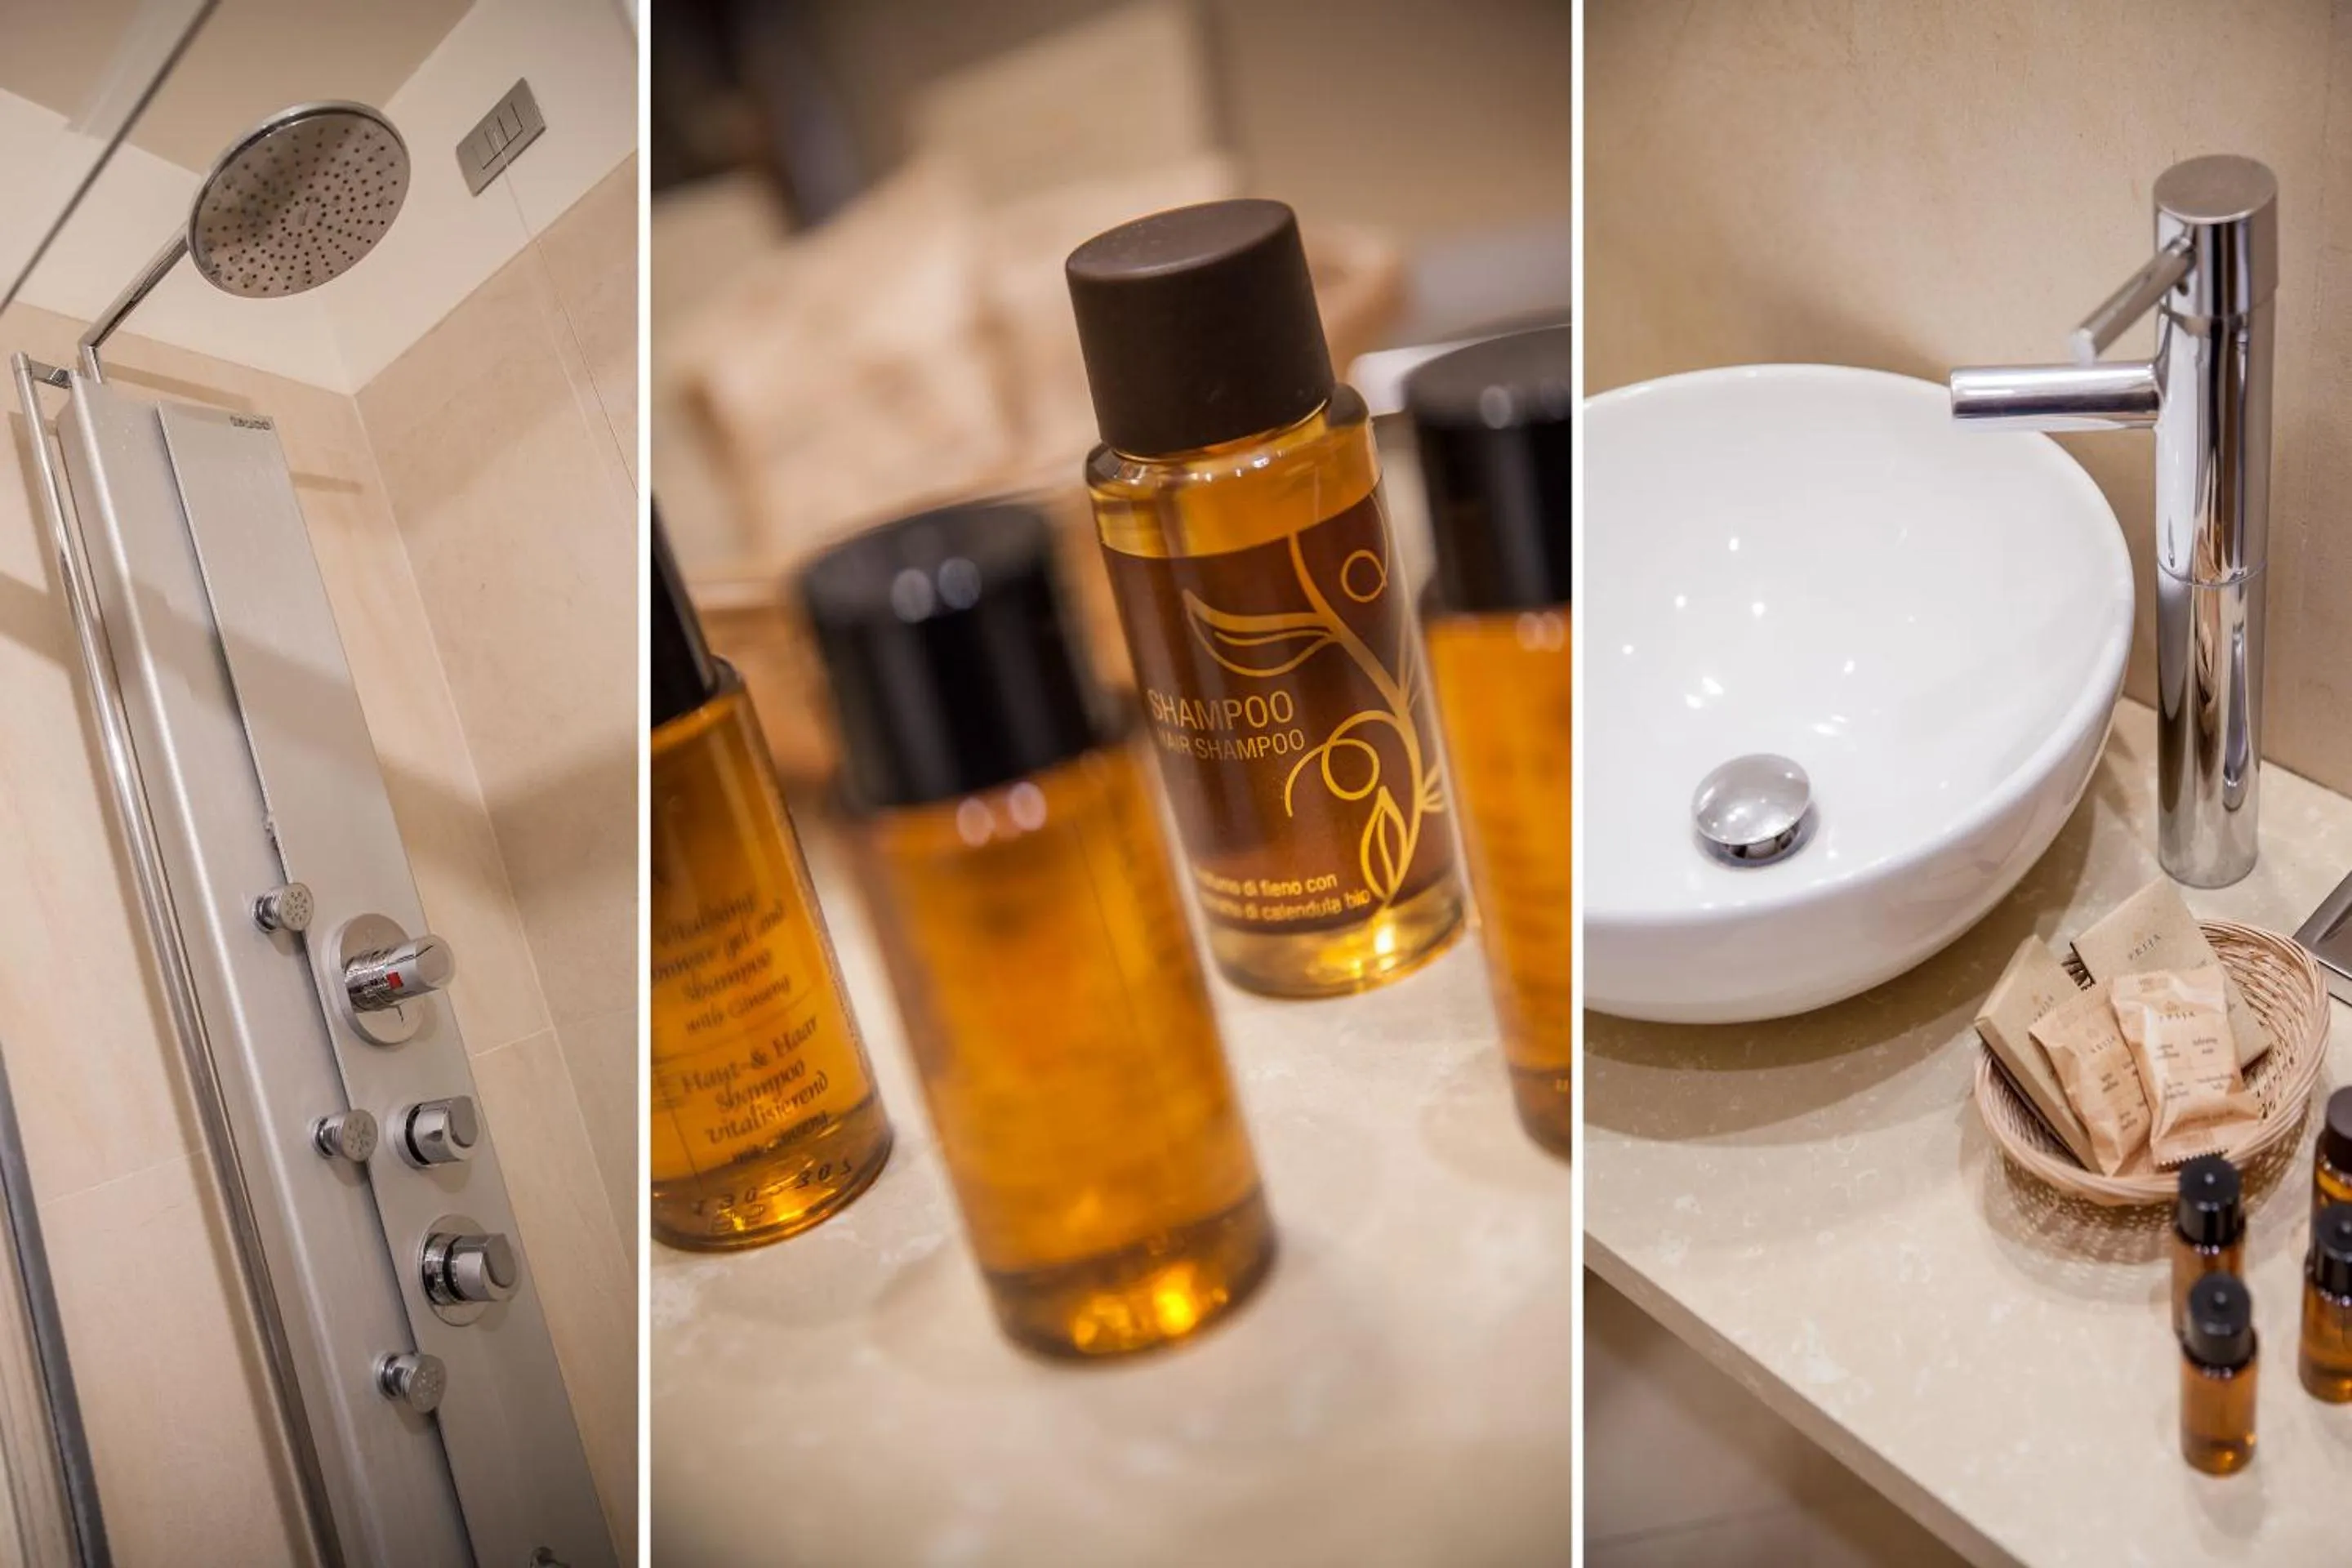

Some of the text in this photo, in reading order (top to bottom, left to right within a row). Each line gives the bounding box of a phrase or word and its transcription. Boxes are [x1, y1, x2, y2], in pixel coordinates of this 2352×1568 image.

[1147, 689, 1294, 731] SHAMPOO
[1195, 728, 1305, 760] SHAMPOO
[1307, 874, 1338, 893] con
[1262, 897, 1342, 920] calendula
[751, 1047, 768, 1070] &
